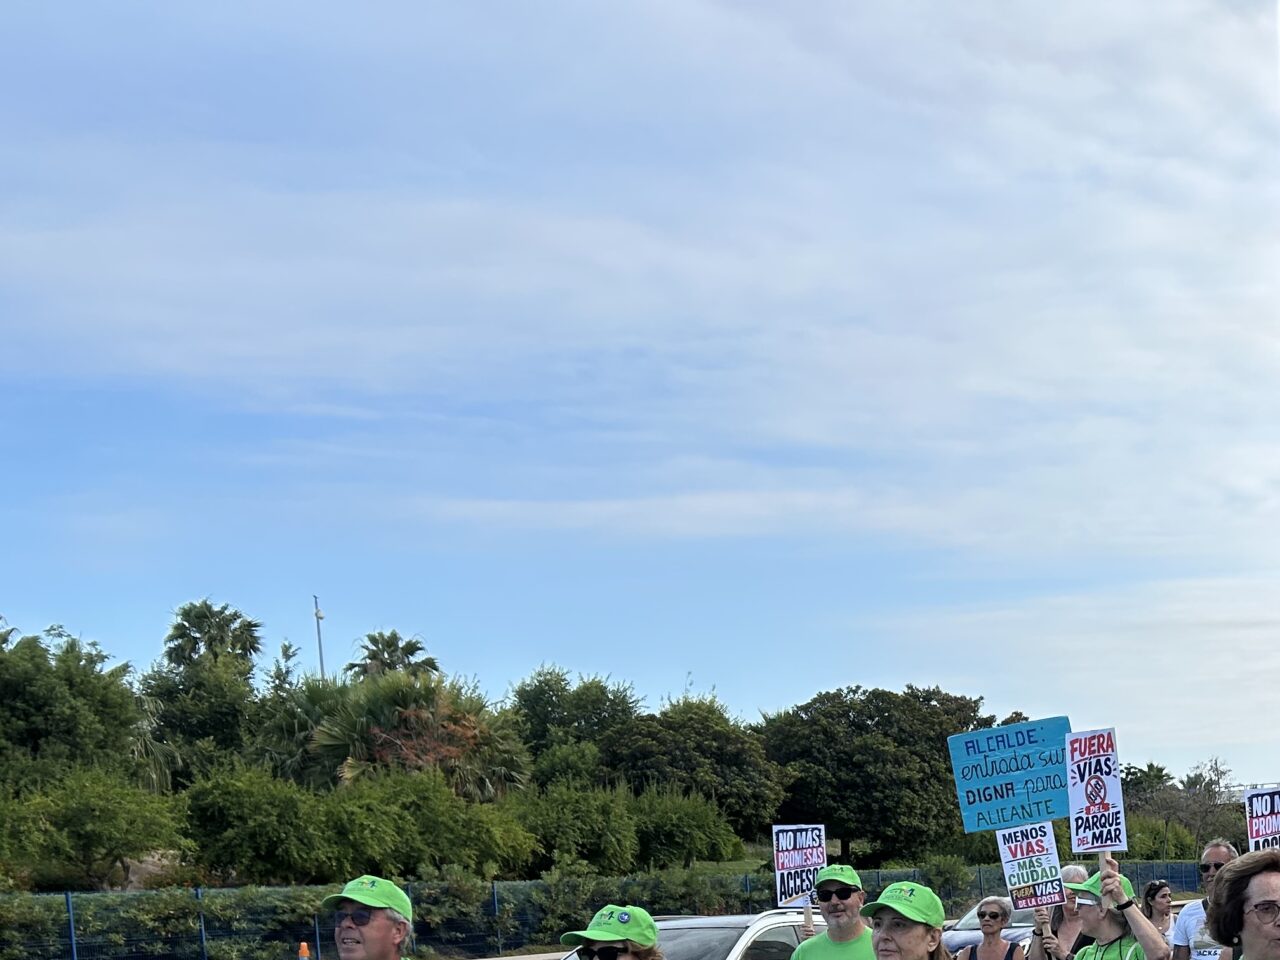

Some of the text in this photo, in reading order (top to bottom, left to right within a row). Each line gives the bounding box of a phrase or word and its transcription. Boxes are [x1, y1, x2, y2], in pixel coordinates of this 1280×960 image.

[965, 727, 1046, 756] ALCALDE:
[1070, 731, 1114, 761] FUERA
[961, 748, 1066, 780] entrada sur
[1077, 756, 1112, 783] VÍAS
[966, 774, 1067, 805] DIGNA para
[977, 799, 1055, 827] ALICANTE
[1090, 804, 1105, 814] DEL
[1252, 795, 1271, 817] NO
[1075, 811, 1122, 836] PARQUE
[778, 829, 819, 851] NO MÁS
[1002, 826, 1047, 845] MENOS
[1077, 828, 1122, 847] DEL MAR
[778, 848, 823, 869] PROMESAS
[1007, 839, 1048, 859] VÍAS,
[1017, 857, 1043, 872] MÁS
[780, 867, 824, 902] ACCESO
[1008, 866, 1058, 886] CIUDAD
[1012, 880, 1060, 899] FUERA VÍAS
[1018, 894, 1060, 908] DE LA COSTA
